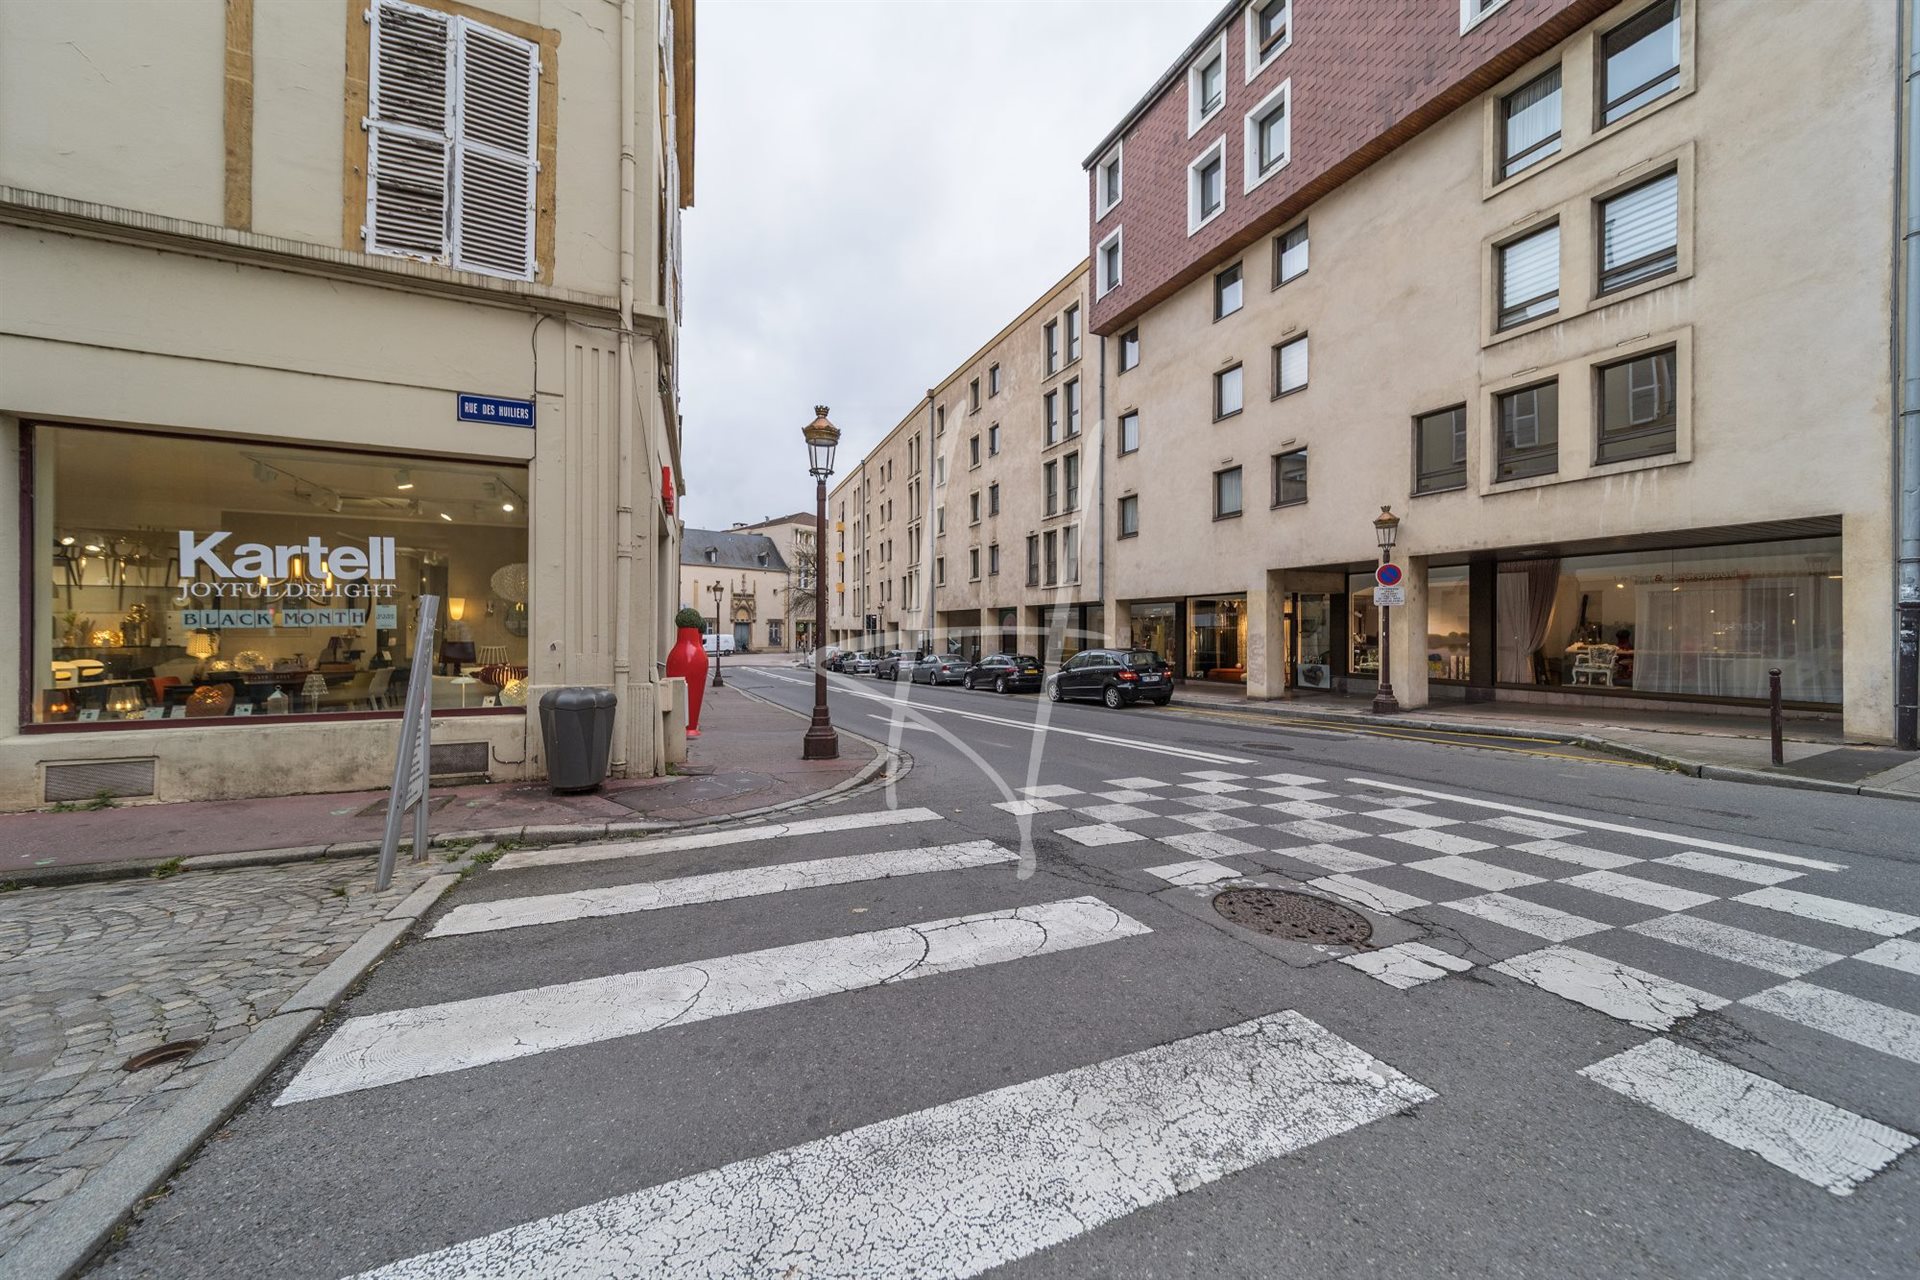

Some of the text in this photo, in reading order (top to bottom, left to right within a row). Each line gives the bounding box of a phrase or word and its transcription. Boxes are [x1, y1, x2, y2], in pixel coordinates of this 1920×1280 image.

[464, 402, 529, 419] RUE DES HUILIERS
[178, 530, 396, 580] Kartell
[177, 582, 397, 600] JOYFUL DELIGHT
[183, 613, 272, 626] BLACK
[284, 612, 365, 625] MONTH
